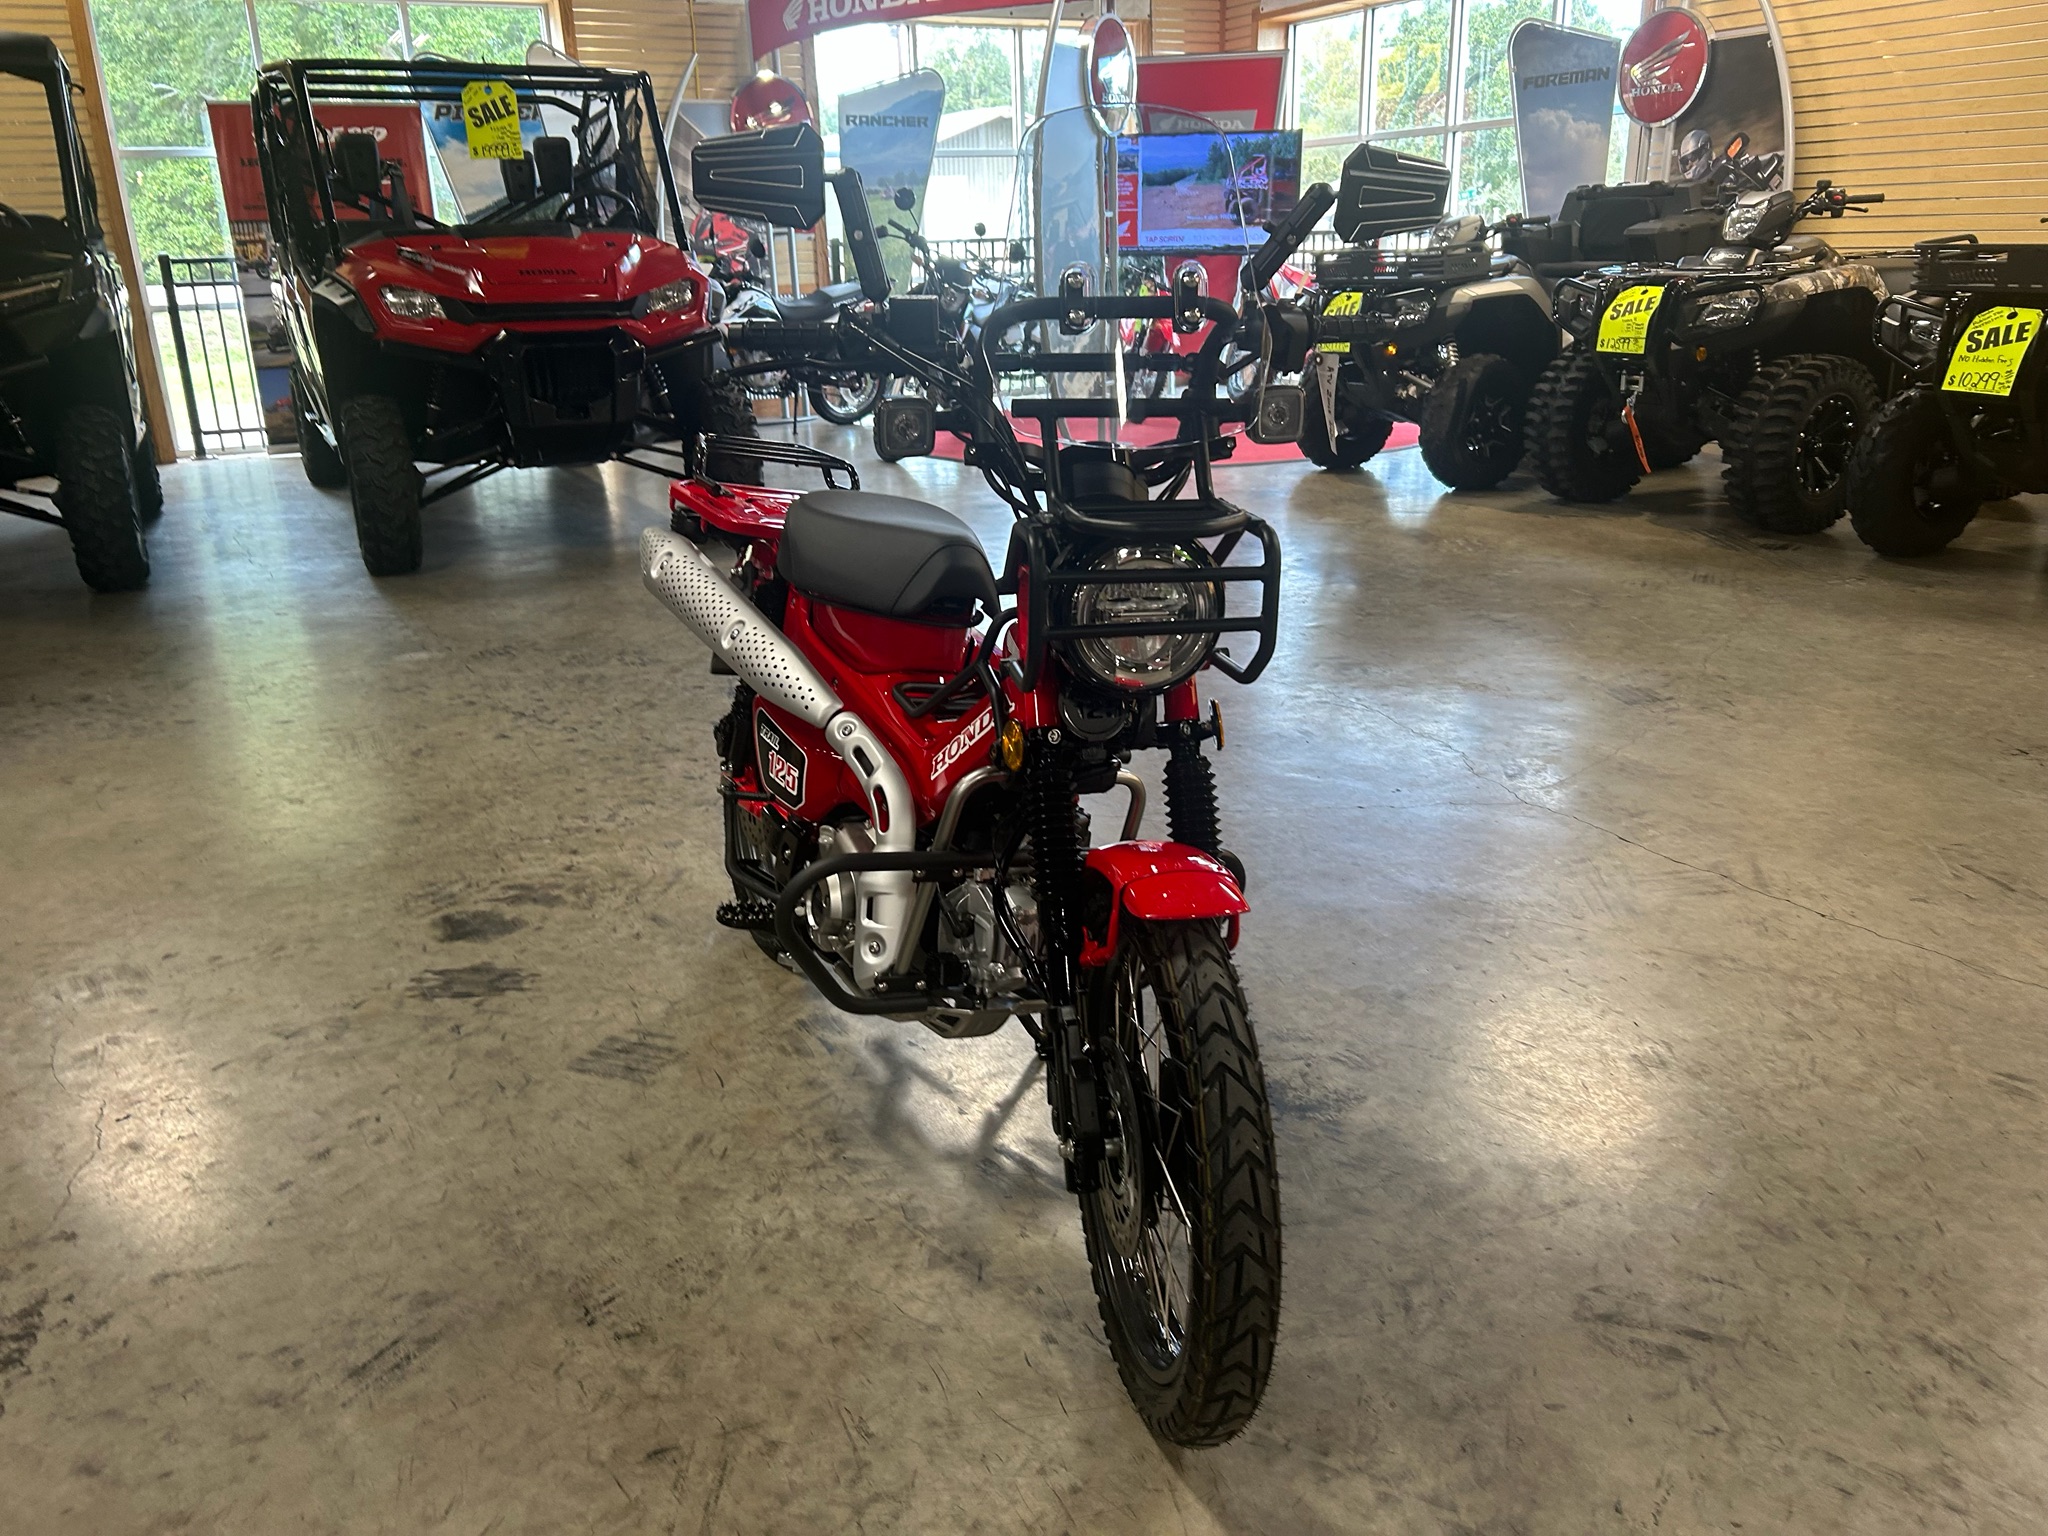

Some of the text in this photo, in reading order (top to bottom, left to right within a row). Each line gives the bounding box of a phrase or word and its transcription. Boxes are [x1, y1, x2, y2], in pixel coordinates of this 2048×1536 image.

[808, 0, 940, 24] HON
[1522, 67, 1610, 90] FOREMAN
[1630, 82, 1683, 97] HONDA
[467, 95, 515, 128] SALE
[846, 113, 929, 129] RANCHER
[1178, 118, 1245, 130] HONDA
[518, 268, 577, 277] HONDA
[1610, 296, 1657, 320] SALE
[1966, 321, 2032, 353] SALE
[760, 722, 780, 751] TRAIL
[769, 750, 799, 796] 125
